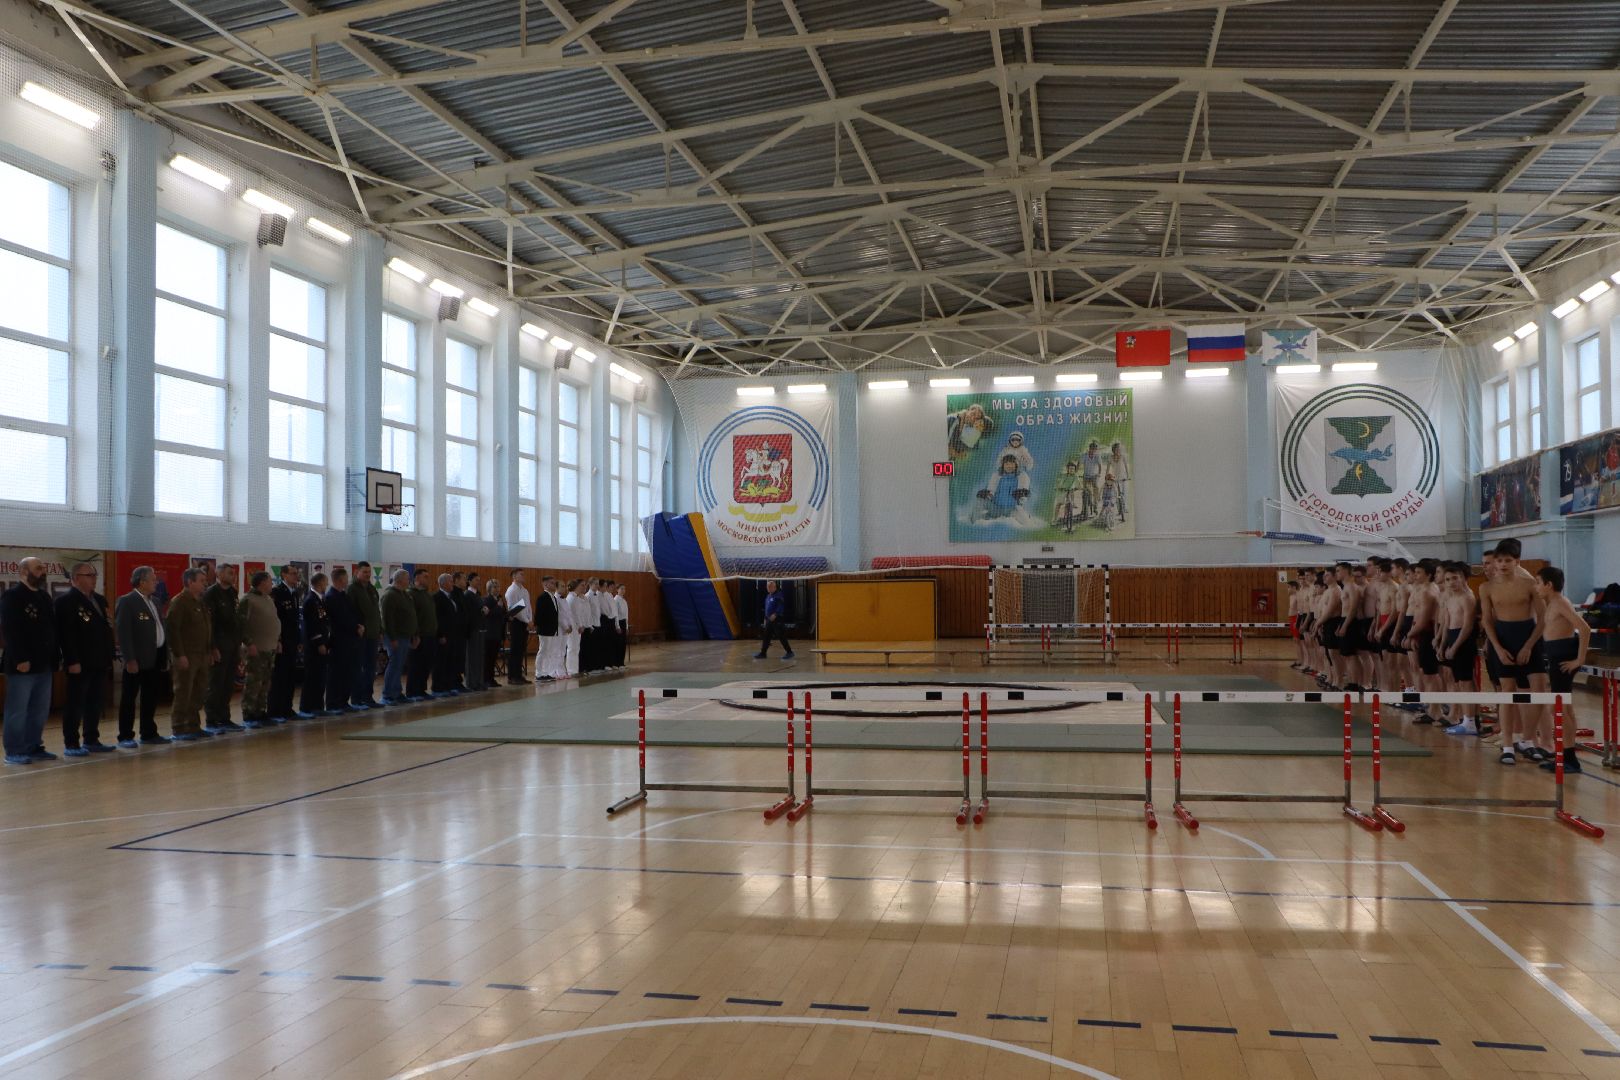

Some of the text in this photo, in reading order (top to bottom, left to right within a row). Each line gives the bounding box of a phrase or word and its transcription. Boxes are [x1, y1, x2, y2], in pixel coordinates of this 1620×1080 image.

[992, 392, 1128, 411] МЫ ЗА ЗДОРОВЫЙ
[1015, 411, 1129, 426] ОБРАЗ ЖИЗНИ!
[934, 463, 953, 475] 00
[1307, 490, 1415, 523] ГОРОДСКОЙ ОКРУГ
[1386, 496, 1425, 529] ПРУДЫ
[715, 517, 812, 545] МОСКОВСКОЙ ОБЛАСТИ
[736, 520, 789, 534] МИНСПОРТ
